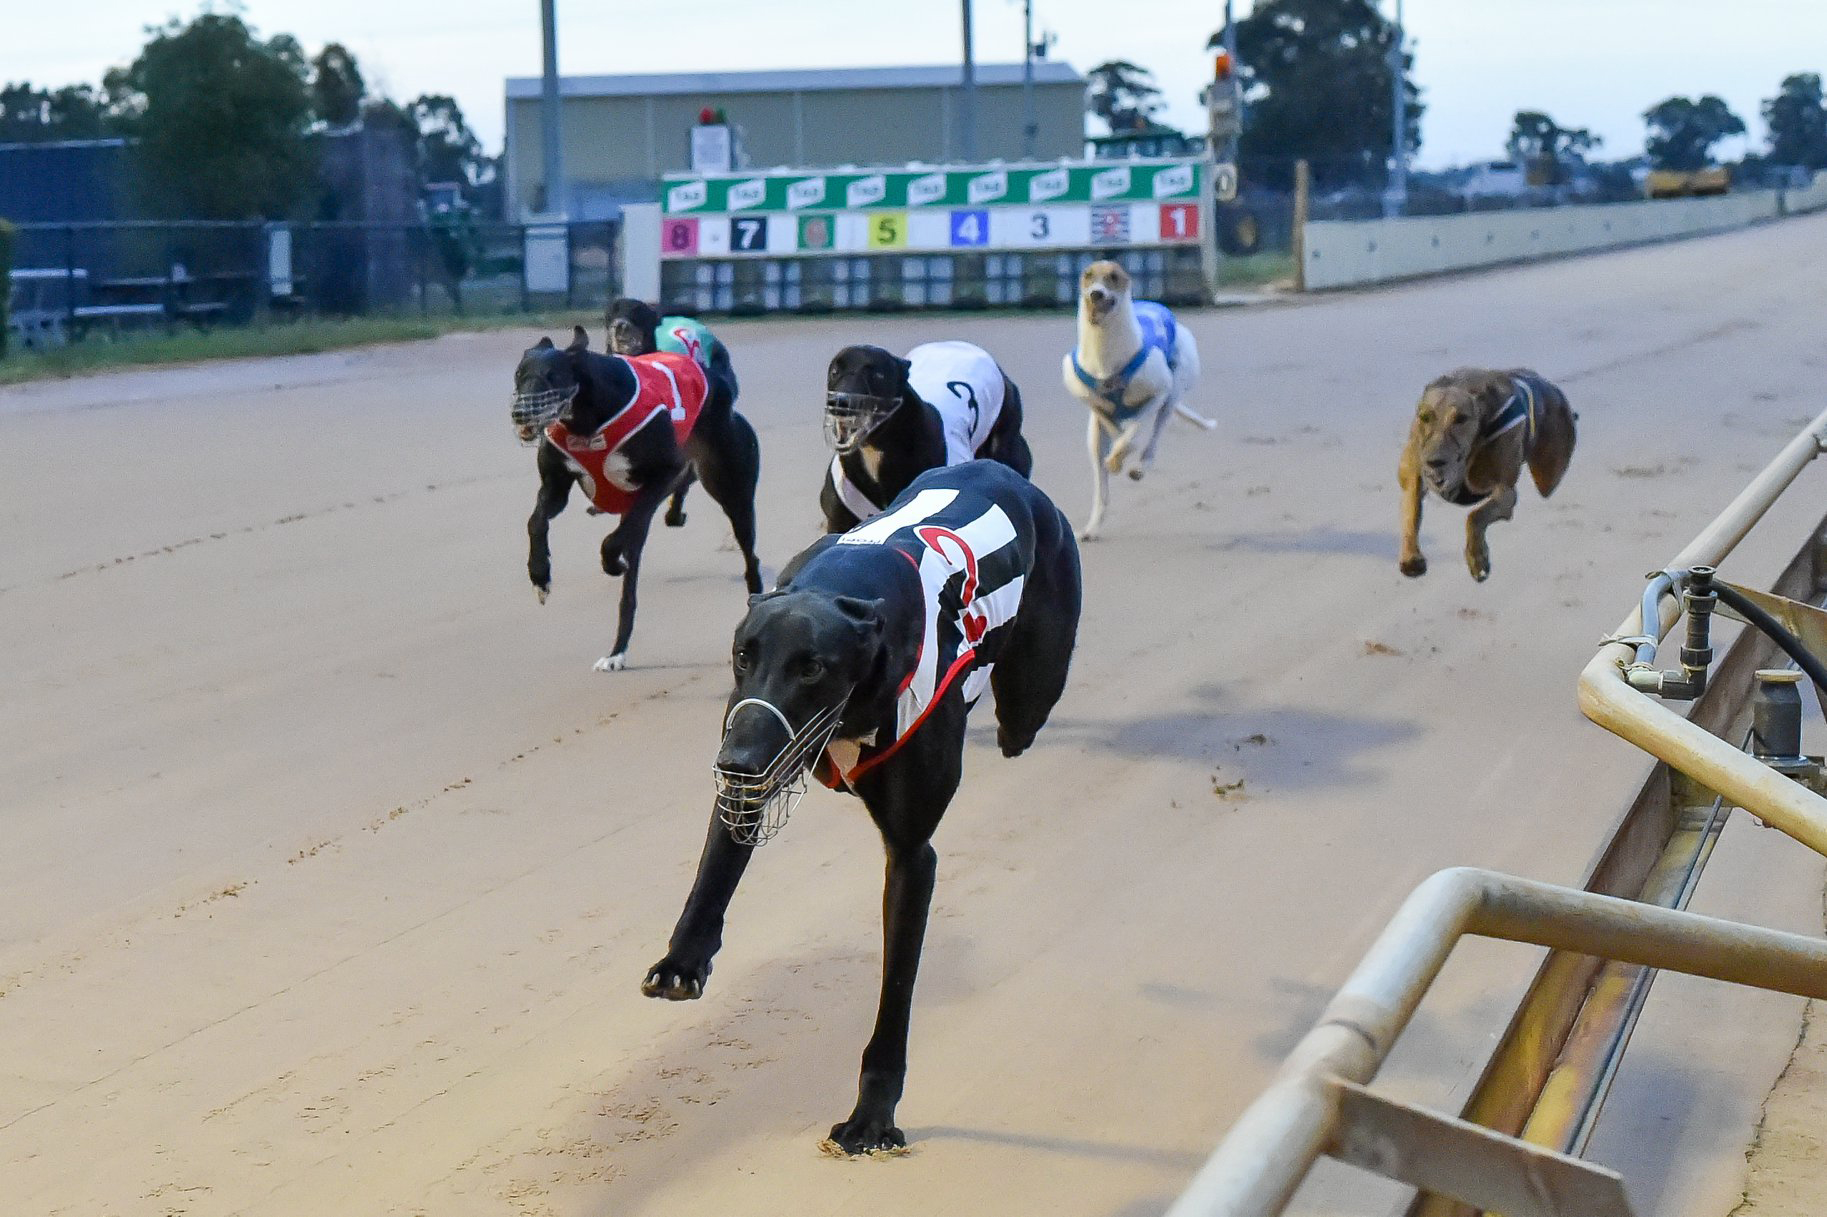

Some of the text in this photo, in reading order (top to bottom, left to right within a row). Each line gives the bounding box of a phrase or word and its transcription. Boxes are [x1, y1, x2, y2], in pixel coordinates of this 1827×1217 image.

[671, 208, 1187, 249] 8 7 5 4 3 1
